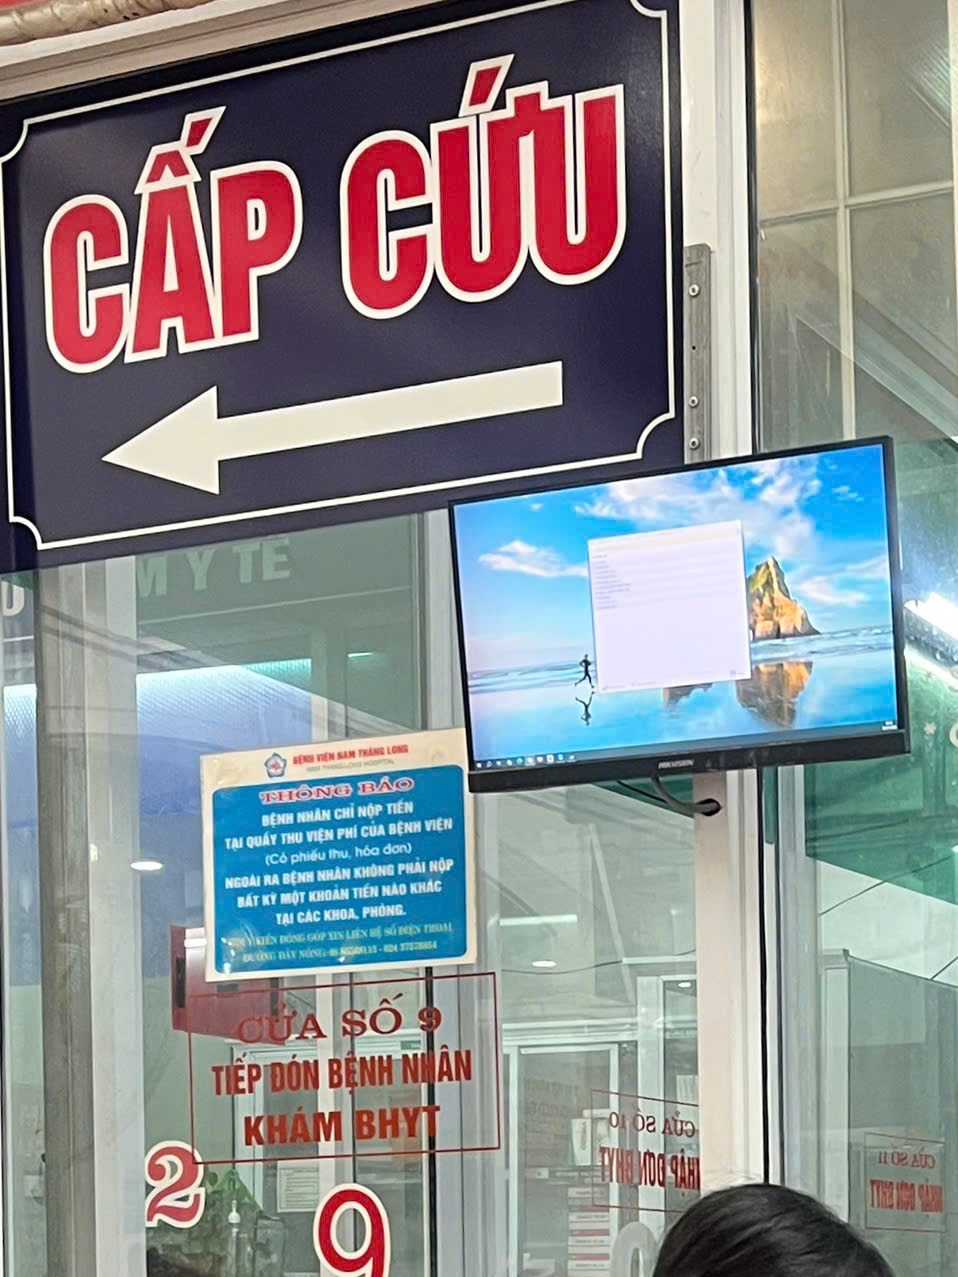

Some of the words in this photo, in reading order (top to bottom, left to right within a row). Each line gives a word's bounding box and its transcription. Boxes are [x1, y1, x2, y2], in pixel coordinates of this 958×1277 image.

[44, 106, 303, 373] CẤP
[340, 54, 627, 319] CỨU
[259, 783, 353, 806] THÔNG
[262, 811, 295, 829] BỆNH
[297, 807, 331, 823] NHÂN
[357, 802, 383, 819] NỘP
[224, 836, 243, 852] TẠI
[280, 832, 304, 845] THU
[306, 827, 335, 844] VIỆN
[336, 824, 358, 840] PHÍ
[360, 820, 386, 838] CỦA
[388, 819, 422, 837] BỆNH
[424, 817, 454, 834] VIỆN
[225, 873, 261, 889] NGOÀI
[263, 874, 281, 886] RA
[282, 869, 315, 887] BỆNH
[353, 863, 395, 879] KHÔNG
[429, 856, 454, 874] NỘP
[410, 877, 443, 895] KHÁC
[276, 912, 295, 927] TẠI
[297, 909, 321, 923] CÁC
[237, 1003, 328, 1043] CỬA
[342, 993, 404, 1036] SỐ
[418, 1006, 442, 1032] 9
[211, 1053, 262, 1096] TIẾP
[270, 1053, 320, 1092] ĐÓN
[328, 1050, 394, 1095] BỆNH
[402, 1045, 473, 1085] NHÂN
[244, 1106, 342, 1146] KHÁM
[355, 1105, 440, 1140] BHYT
[144, 1140, 206, 1228] 2
